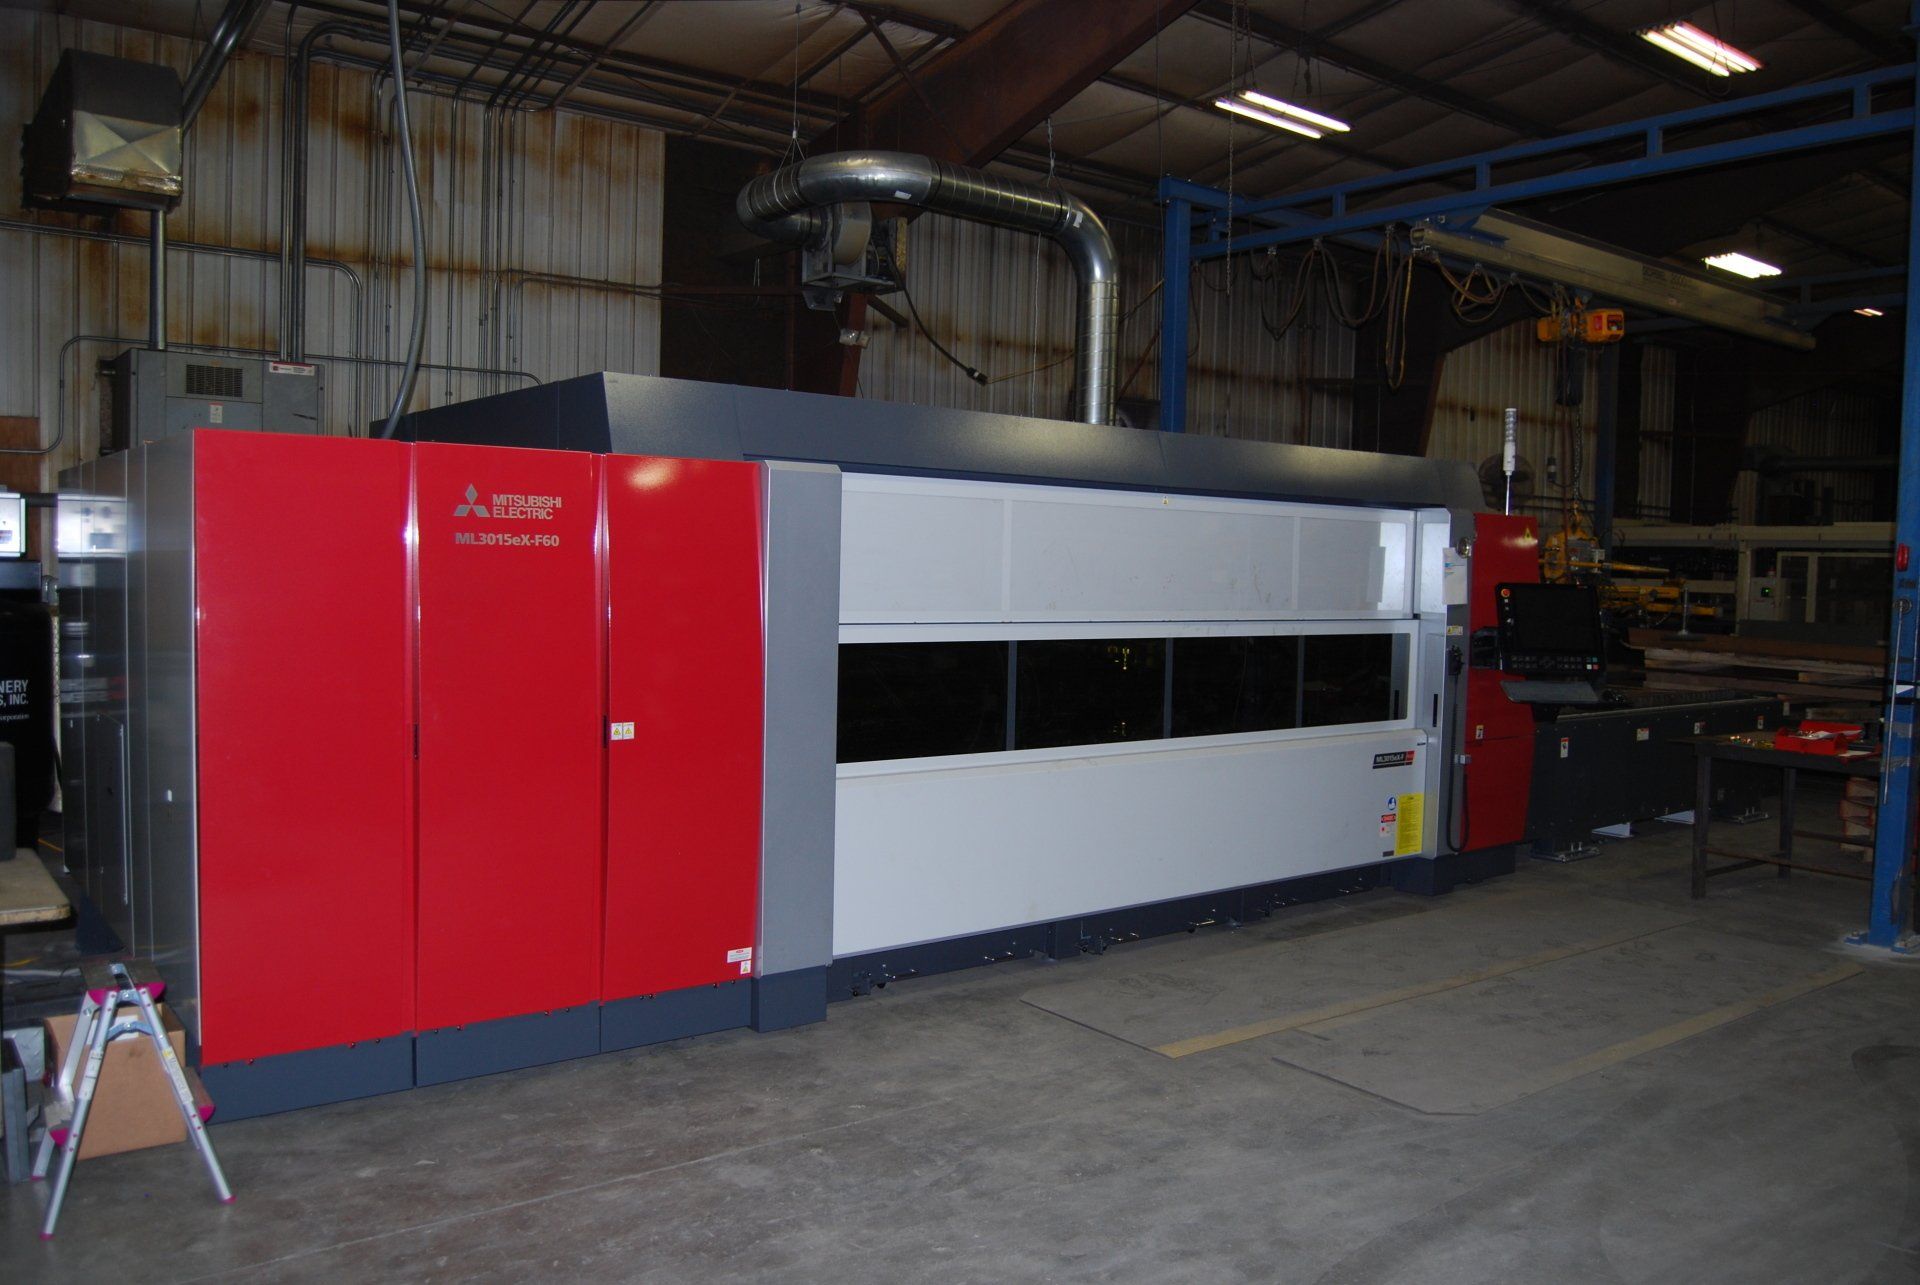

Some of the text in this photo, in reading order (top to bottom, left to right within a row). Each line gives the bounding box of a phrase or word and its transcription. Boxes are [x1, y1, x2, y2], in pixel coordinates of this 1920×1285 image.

[492, 494, 562, 508] MITSUBISHI
[493, 507, 553, 519] ELECTRIC
[455, 533, 559, 547] ML3015eX-F60
[9, 693, 29, 705] INC.
